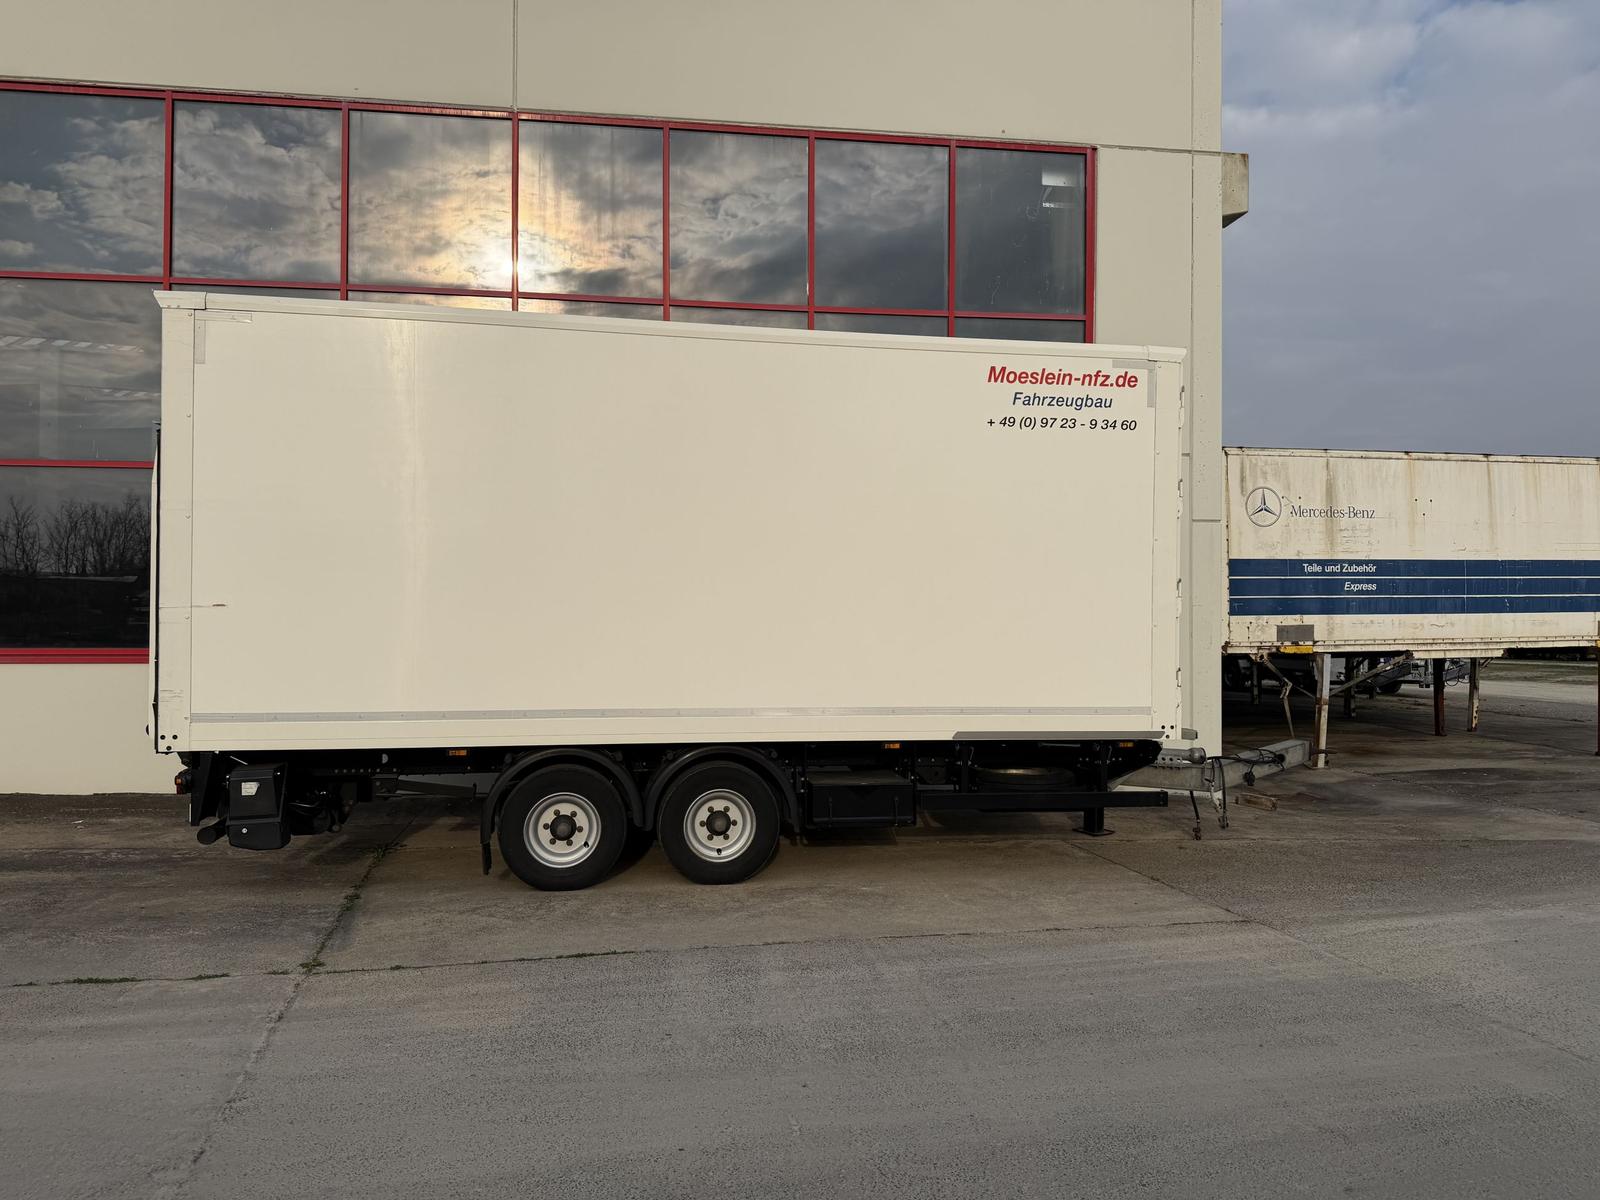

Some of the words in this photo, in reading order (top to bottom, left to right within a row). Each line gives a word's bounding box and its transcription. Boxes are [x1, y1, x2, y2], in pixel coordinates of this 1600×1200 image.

[987, 365, 1139, 388] Moeslein-nfz.de
[1012, 391, 1113, 411] Fahrzeugbau
[999, 416, 1016, 428] 49
[1019, 417, 1037, 430] (0)
[1291, 505, 1376, 519] Mercedes-Benz
[1303, 563, 1323, 573] Teile
[1324, 563, 1341, 573] und
[1342, 563, 1377, 573] Zubehör
[1344, 581, 1377, 591] Express
